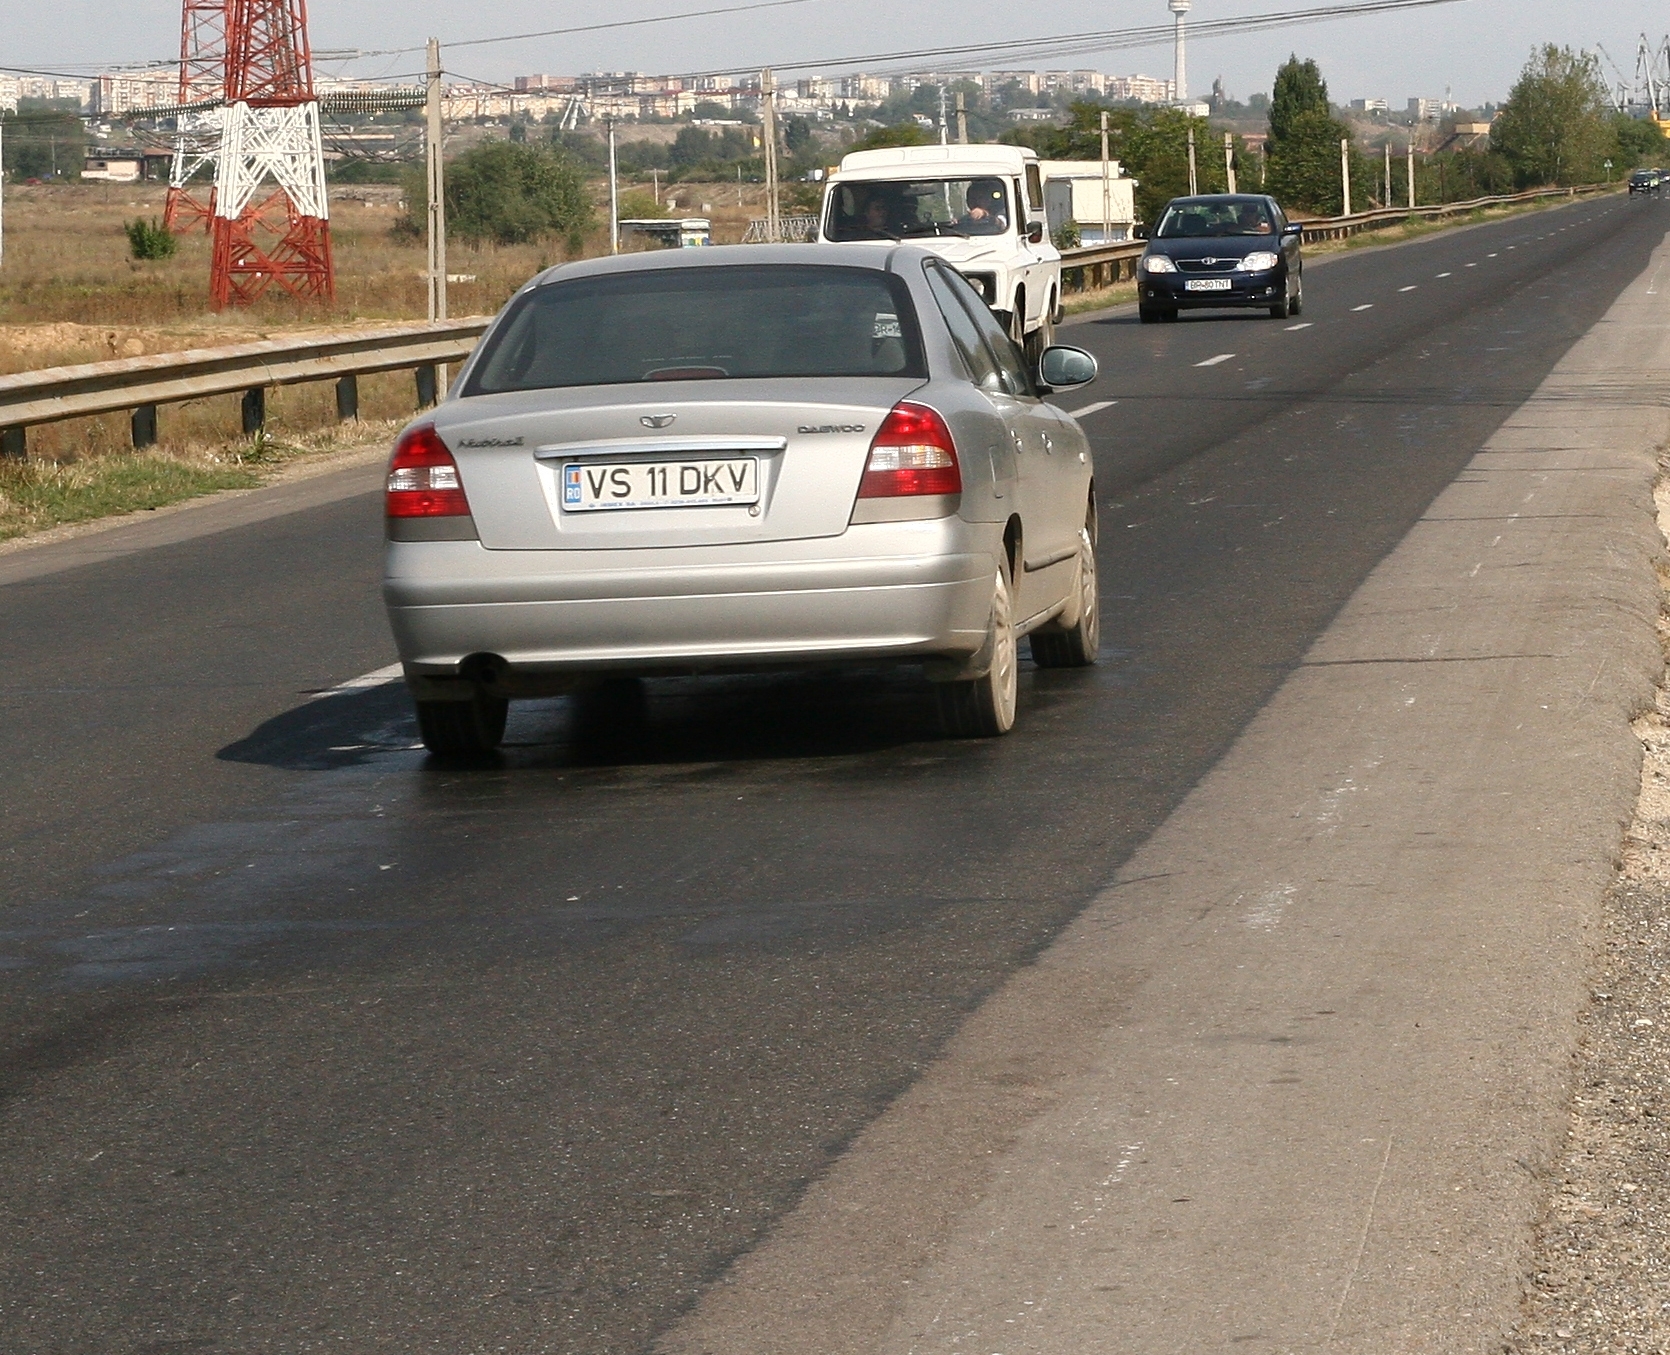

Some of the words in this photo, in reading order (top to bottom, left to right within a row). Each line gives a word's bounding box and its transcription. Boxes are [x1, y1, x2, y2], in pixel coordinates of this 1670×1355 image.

[797, 425, 865, 433] DAEWOO
[587, 468, 631, 499] VS
[647, 467, 667, 496] 11
[680, 463, 748, 495] DKV
[567, 487, 580, 499] RO
